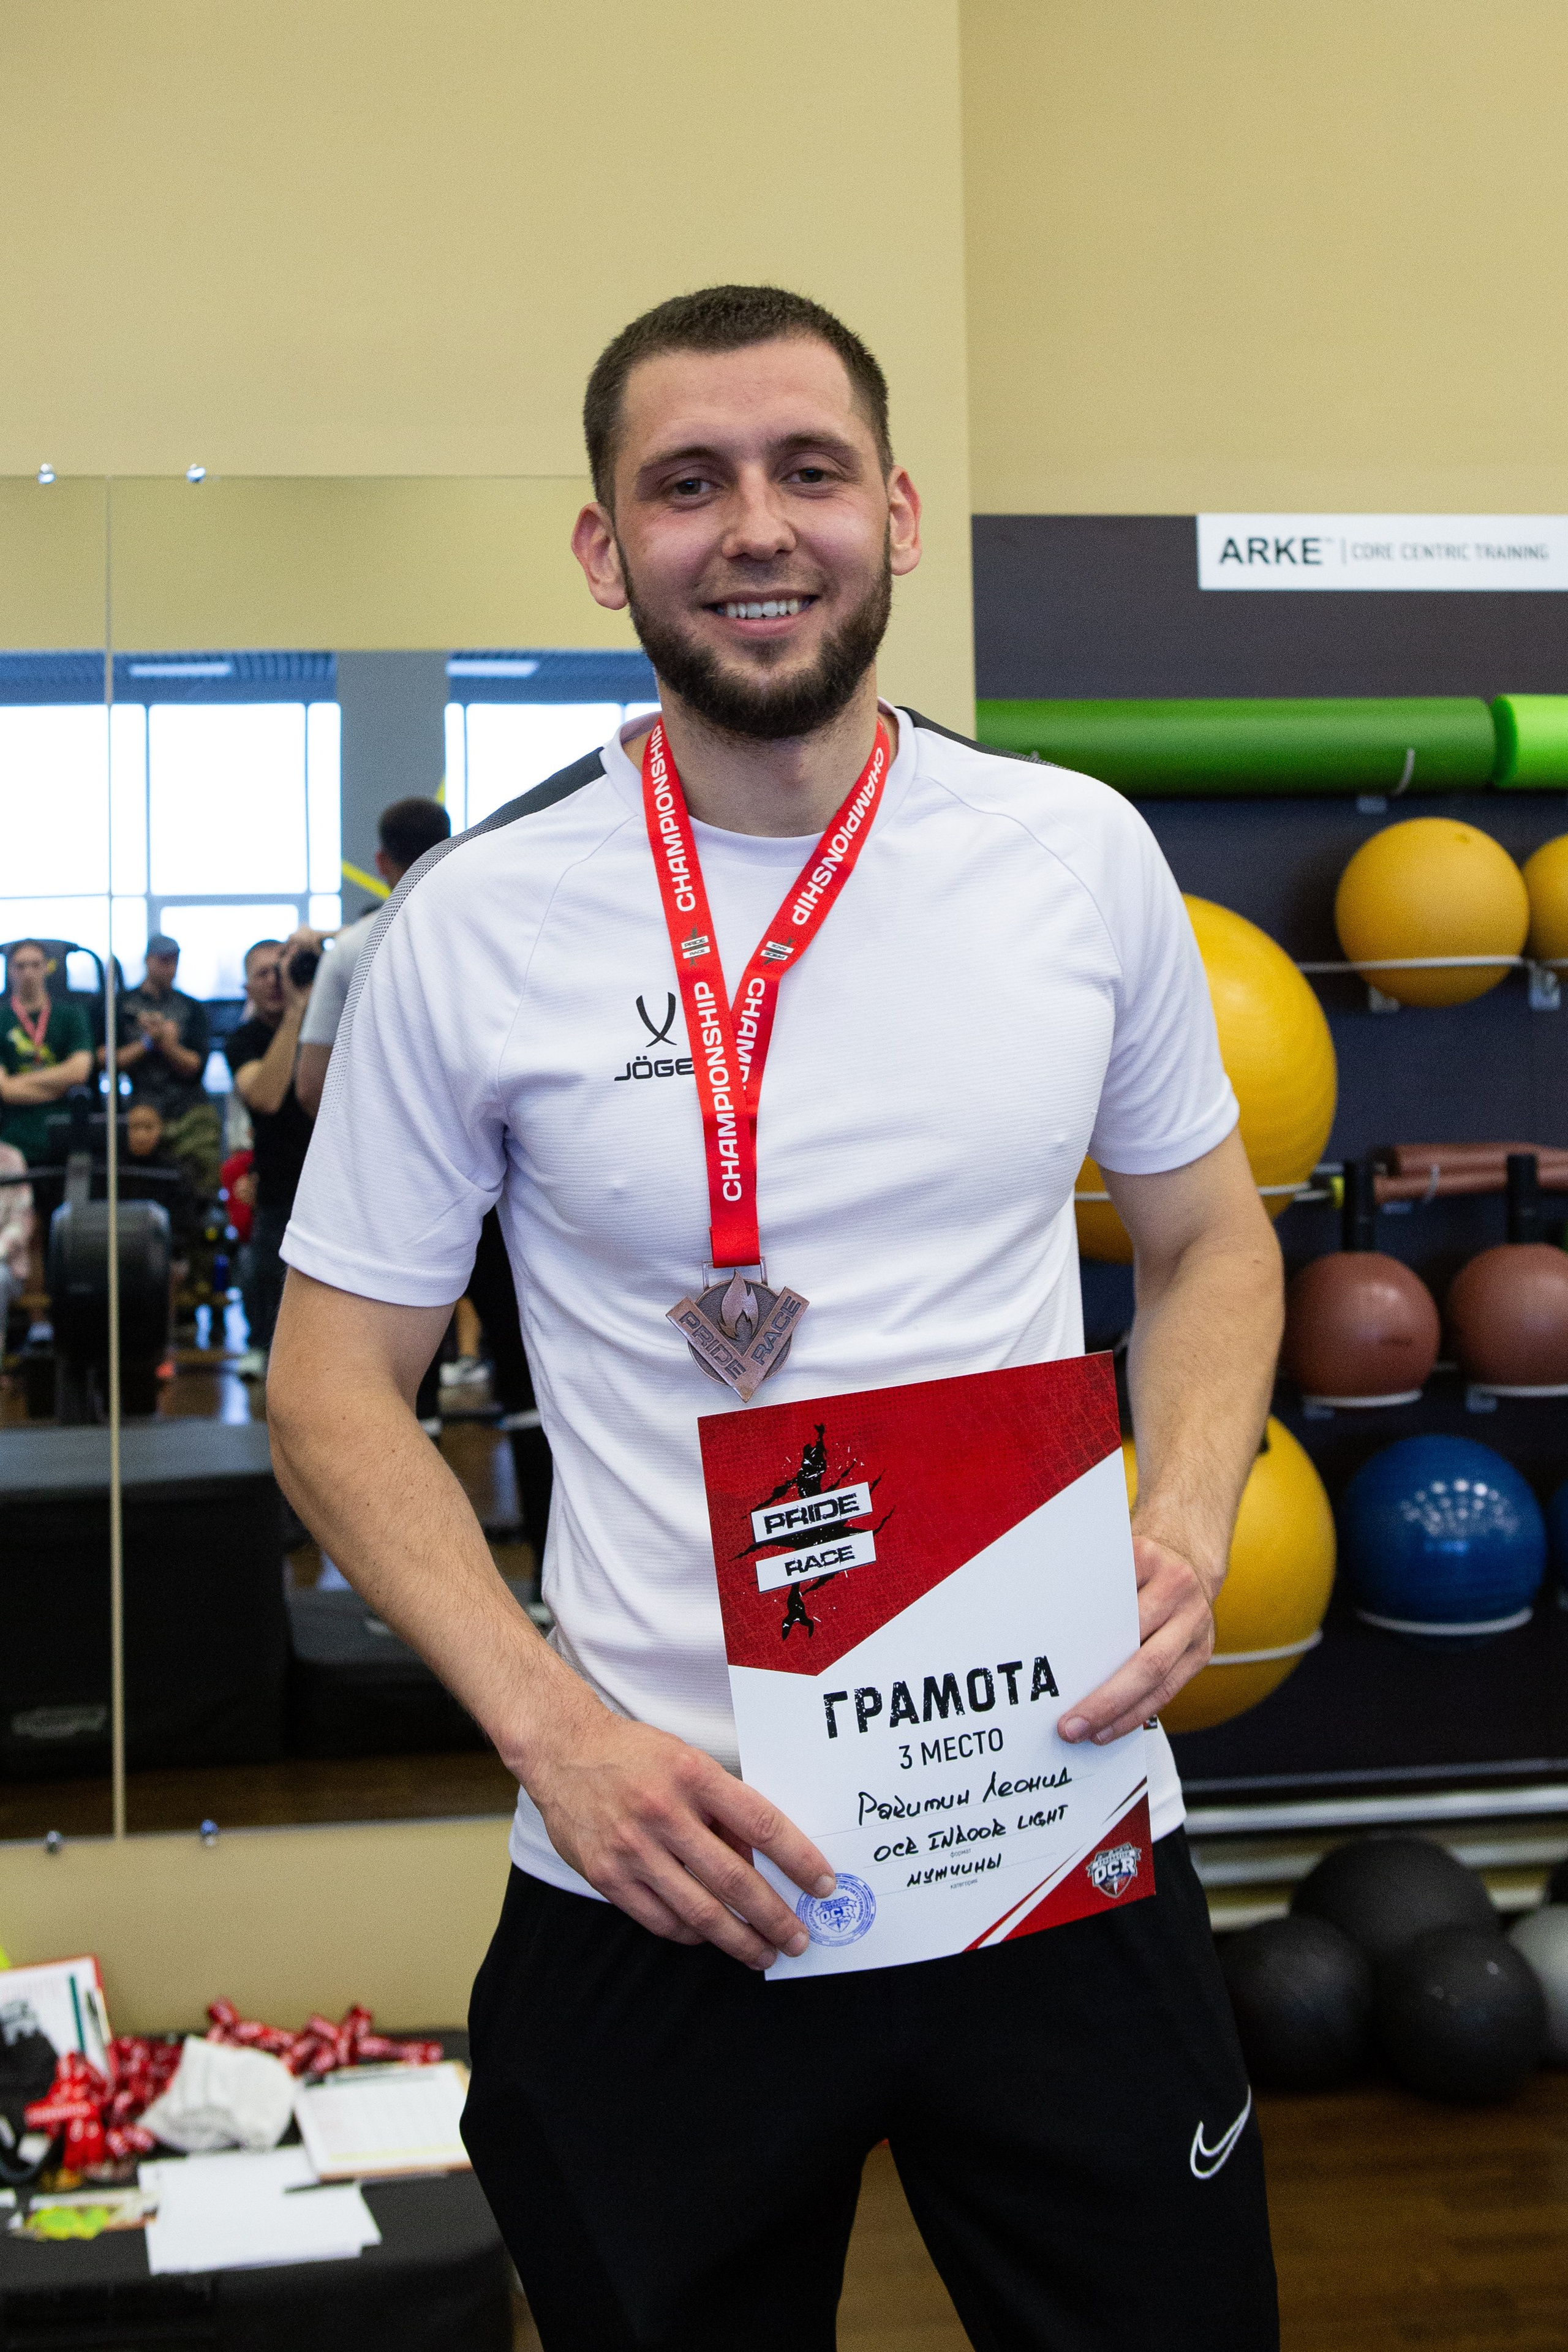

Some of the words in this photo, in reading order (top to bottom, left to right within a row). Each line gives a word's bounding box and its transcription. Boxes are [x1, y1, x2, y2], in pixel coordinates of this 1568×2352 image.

[1219, 537, 1322, 565] ARKE
[1351, 543, 1395, 561] CORE
[1401, 543, 1470, 562] CENTRIC
[1474, 543, 1550, 562] TRAINING
[649, 725, 696, 912] CHAMPIONSHIP
[792, 747, 884, 925] CHAMPIONSHIP
[684, 938, 706, 948] PRIDE
[736, 978, 766, 1090] CHAMP
[614, 1055, 695, 1082] JÖGE
[694, 981, 742, 1202] CHAMPIONSHIP
[679, 1311, 747, 1381] PRIDE
[750, 1295, 801, 1366] RACE
[763, 1493, 860, 1535] PRIDE
[784, 1545, 856, 1577] RACE
[823, 1655, 1060, 1739] ГРАМОТА
[899, 1745, 913, 1770] 3
[921, 1728, 1003, 1766] МЕСТО
[1017, 1804, 1069, 1830] LIGHT
[1093, 1856, 1136, 1885] OCR
[819, 1905, 856, 1924] OCR
